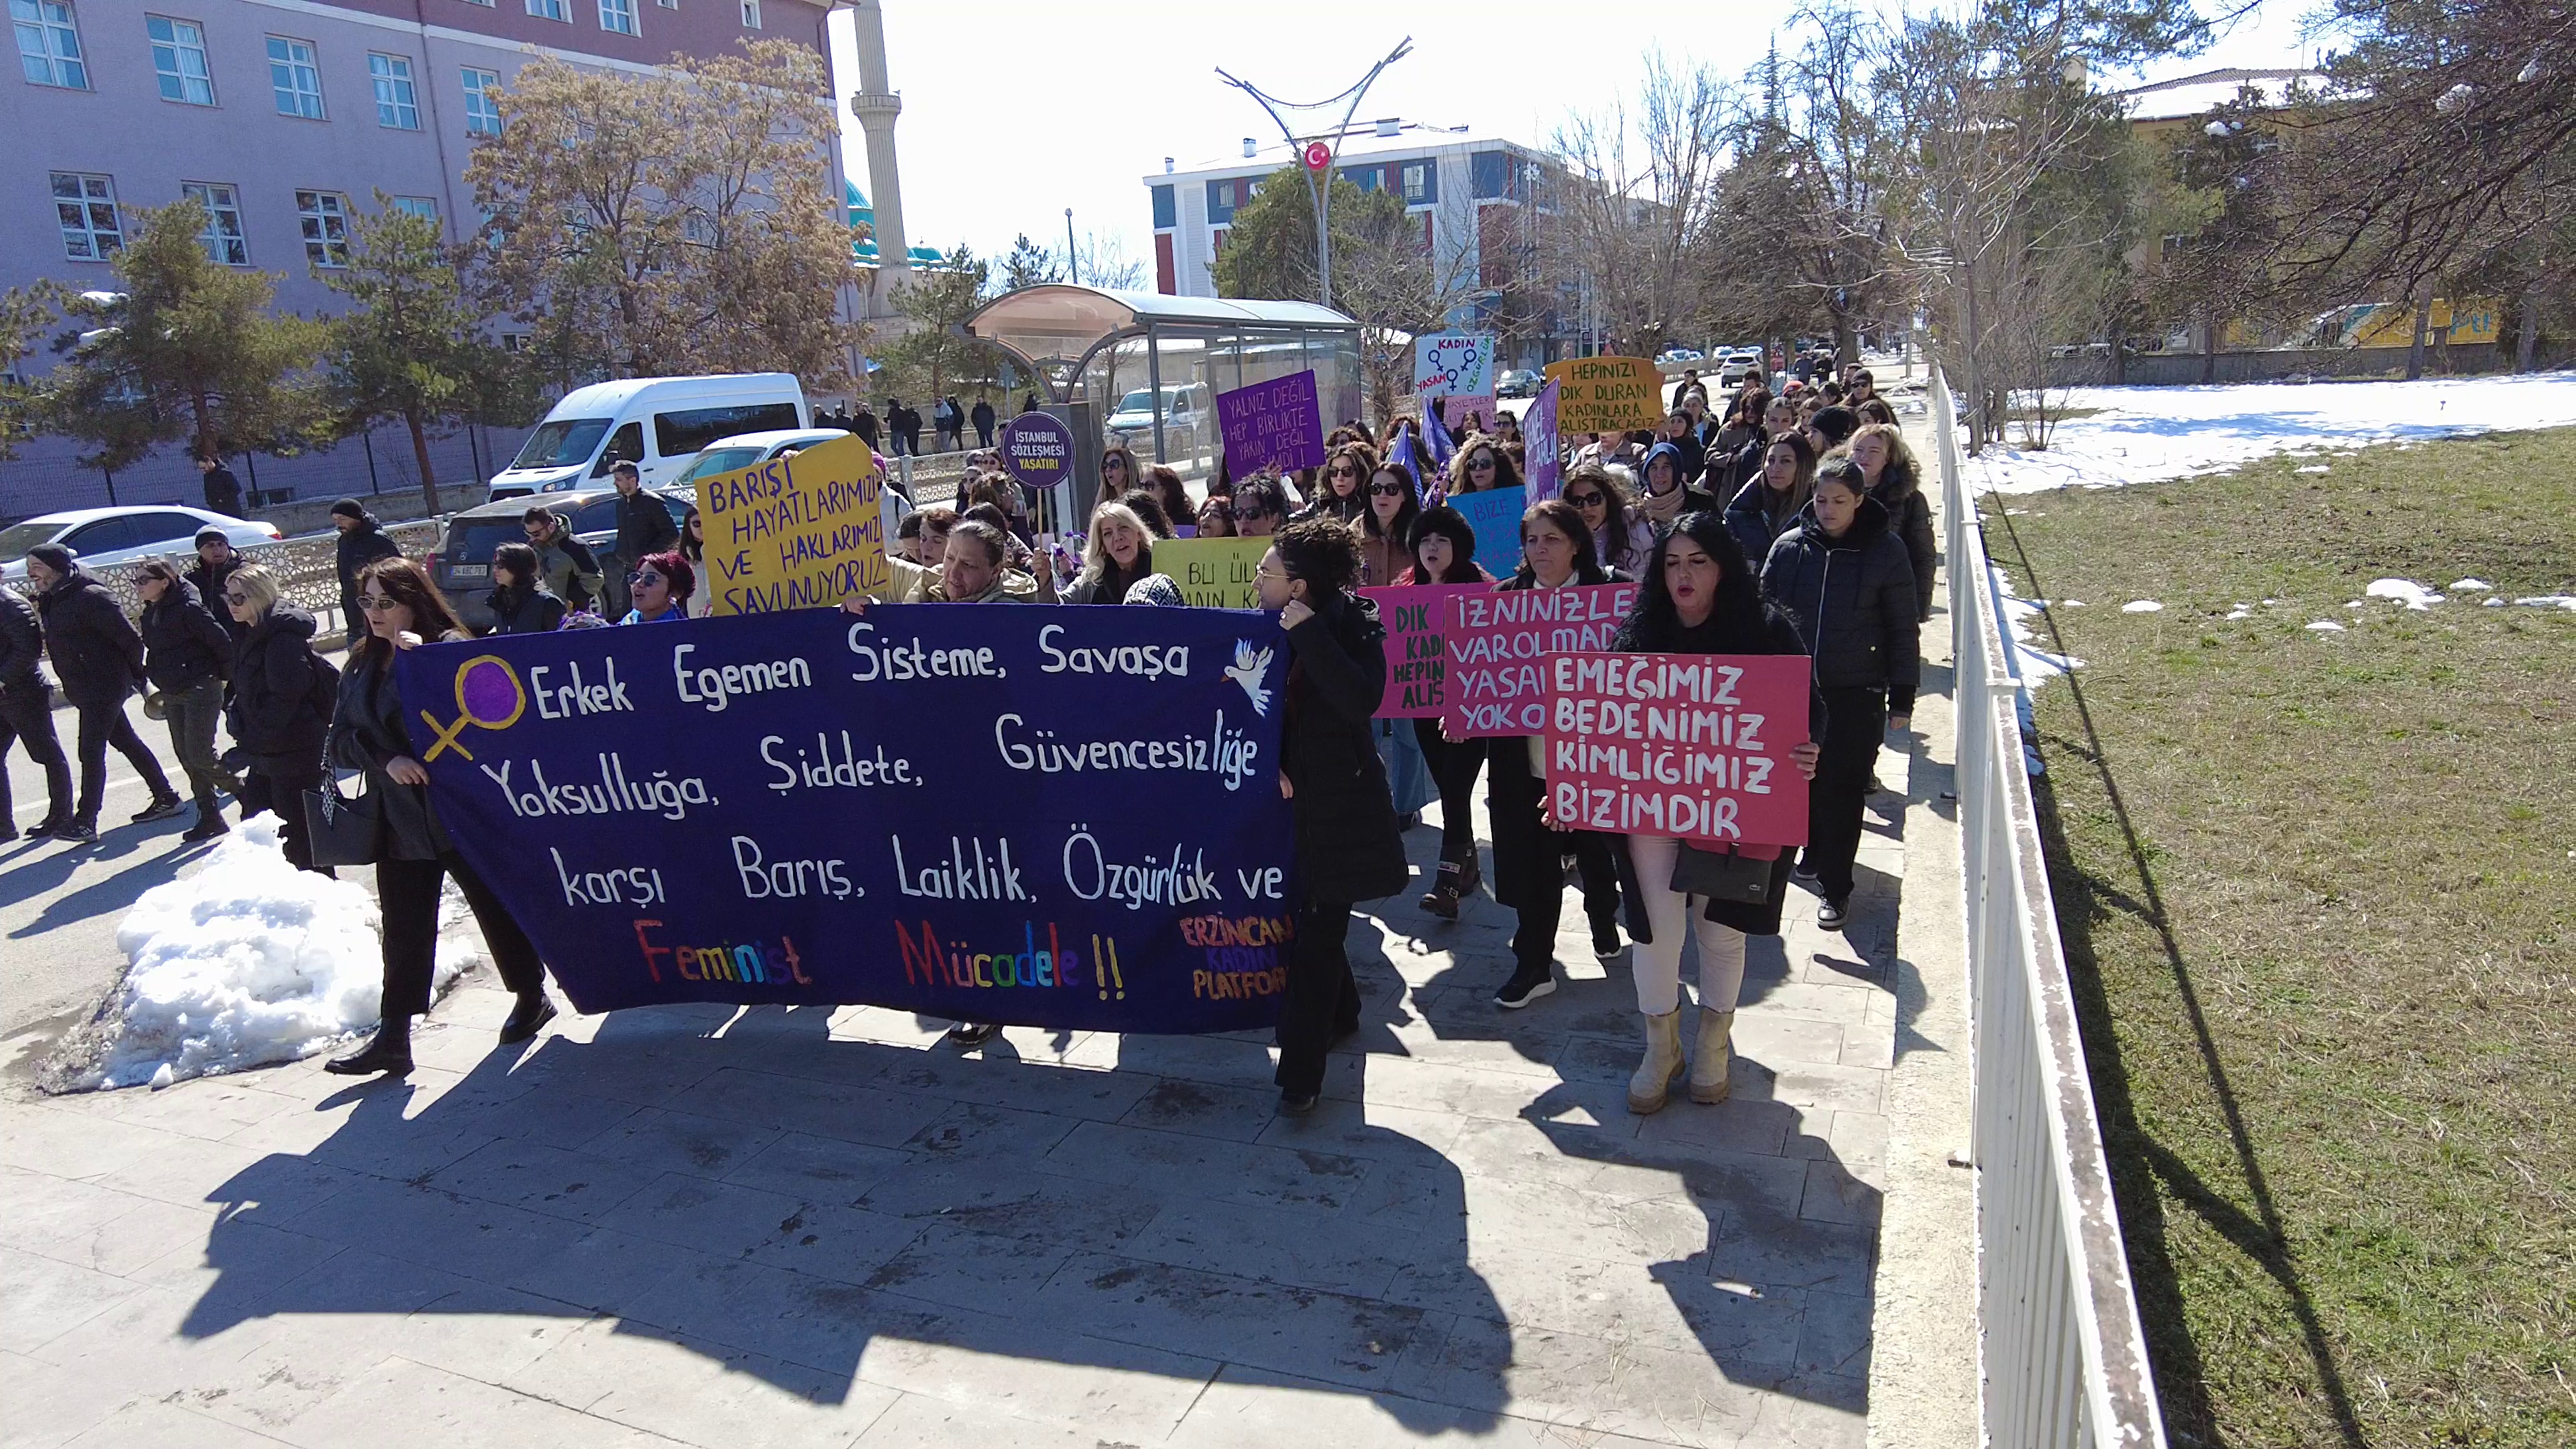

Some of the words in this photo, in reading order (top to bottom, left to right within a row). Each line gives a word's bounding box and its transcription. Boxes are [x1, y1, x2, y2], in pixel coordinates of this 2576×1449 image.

[1438, 338, 1475, 350] KADIN
[1572, 361, 1637, 380] HEPİNİZİ
[1227, 392, 1267, 419] YALNIZ
[1273, 379, 1311, 408] DEĞİL
[1564, 402, 1642, 417] KADINLARA
[1595, 383, 1647, 400] DURAN
[1015, 430, 1058, 443] İSTANBUL
[1229, 423, 1246, 441] HEP
[1256, 407, 1307, 435] BİRLİKTE
[1010, 443, 1065, 458] SÖZLEŞMESİ
[1238, 439, 1265, 461] YARIN
[1276, 429, 1309, 451] DEĞİL
[709, 462, 793, 514] BARIŞI
[733, 475, 877, 544] HAYATLARIMIZI
[717, 550, 753, 580] VE
[780, 513, 883, 572] HAKLARIMIZI
[724, 549, 887, 614] SAVUNUYORUZ
[1189, 562, 1214, 584] BU
[1230, 552, 1258, 583] ÜL
[1396, 598, 1430, 633] DİK
[1458, 588, 1632, 629] İZNİNİZLE
[531, 656, 635, 719] Erkek
[674, 644, 812, 712] Egemen
[848, 622, 1006, 682] Sisteme,
[1038, 624, 1189, 682] Savaşa
[1555, 656, 1743, 705] EMEĞİMİZ
[1458, 703, 1515, 731] YOK
[1555, 698, 1765, 751] BEDENİMİZ
[480, 753, 720, 820] Yoksulluğa,
[760, 729, 923, 796] Şiddete,
[995, 708, 1258, 792] Güvencesizliğe
[1556, 780, 1741, 839] BİZİMDİR
[550, 847, 665, 909] karşı
[731, 835, 865, 901] Barış,
[892, 834, 1037, 904] Laiklik,
[1063, 822, 1222, 910] Özgürlük
[1237, 867, 1283, 899] ve
[1179, 911, 1294, 947] ERZİNCAN
[633, 919, 812, 985] Feminist
[895, 920, 1079, 987] Mücadele
[1091, 933, 1126, 1000] !!
[1205, 947, 1278, 972] KADIN
